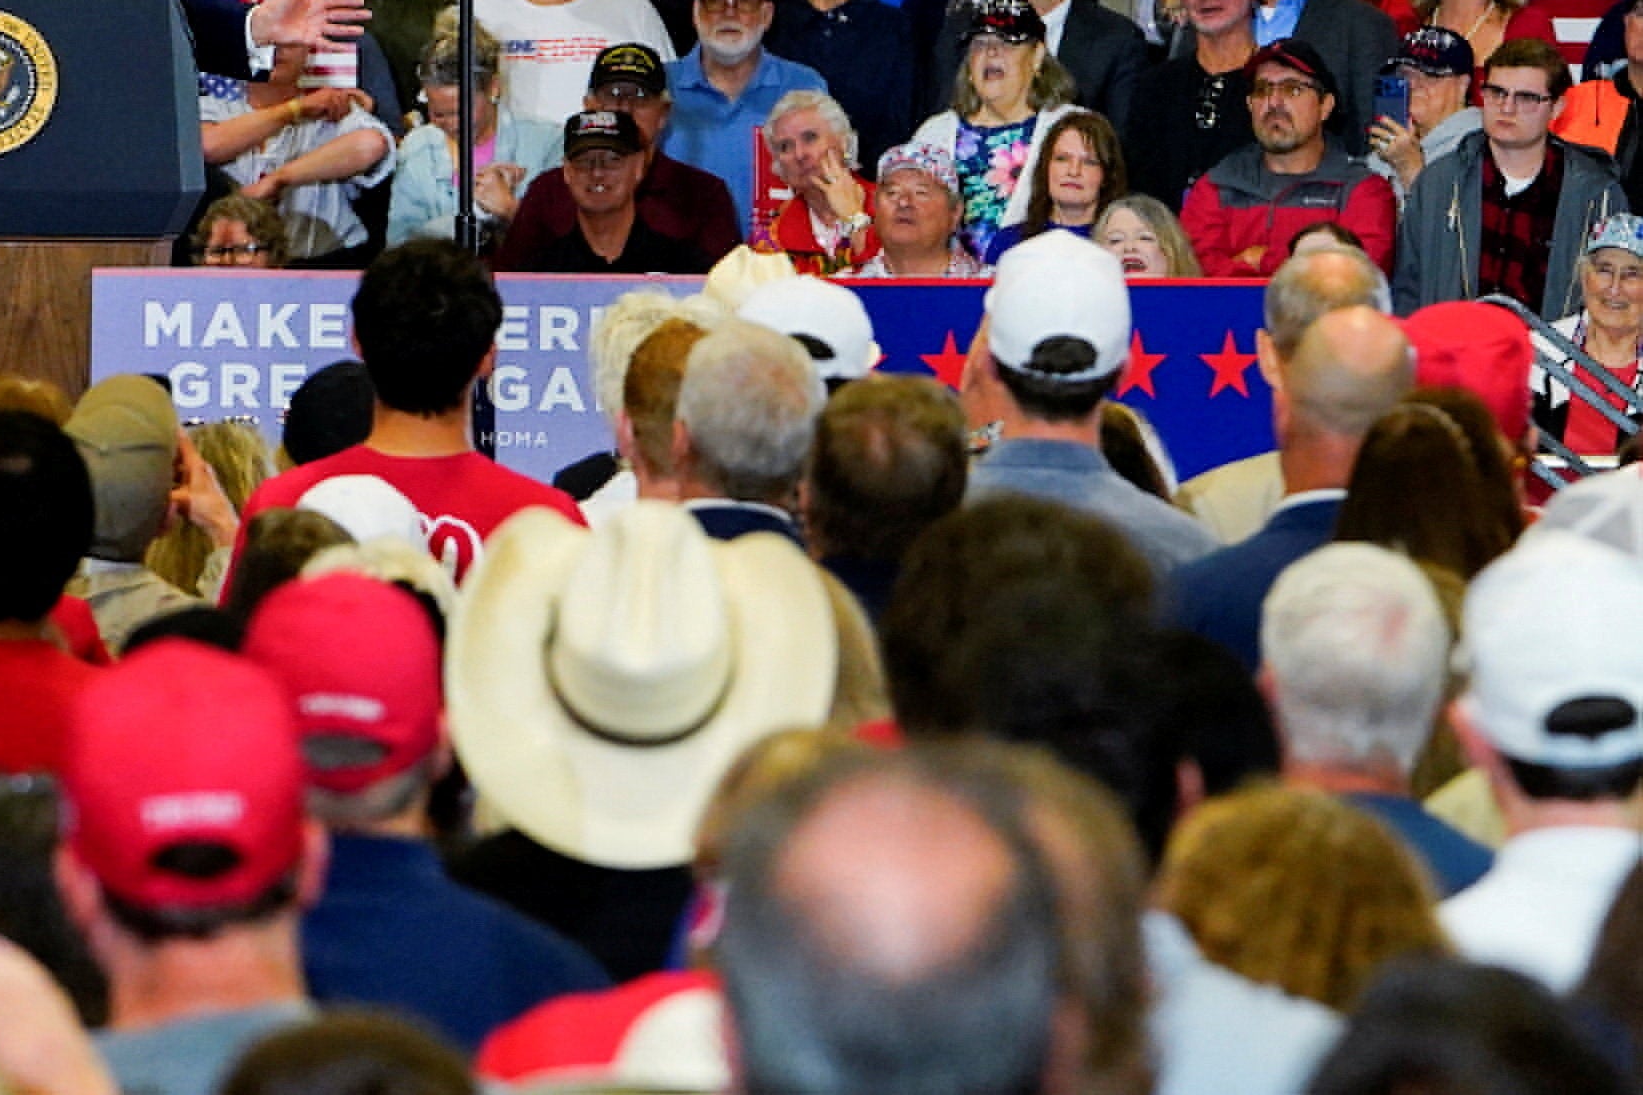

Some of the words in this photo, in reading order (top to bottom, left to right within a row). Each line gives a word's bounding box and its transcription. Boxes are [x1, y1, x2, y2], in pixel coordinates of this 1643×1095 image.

[142, 301, 350, 349] MAKE
[170, 360, 309, 411] GRE
[478, 430, 549, 449] HOMA
